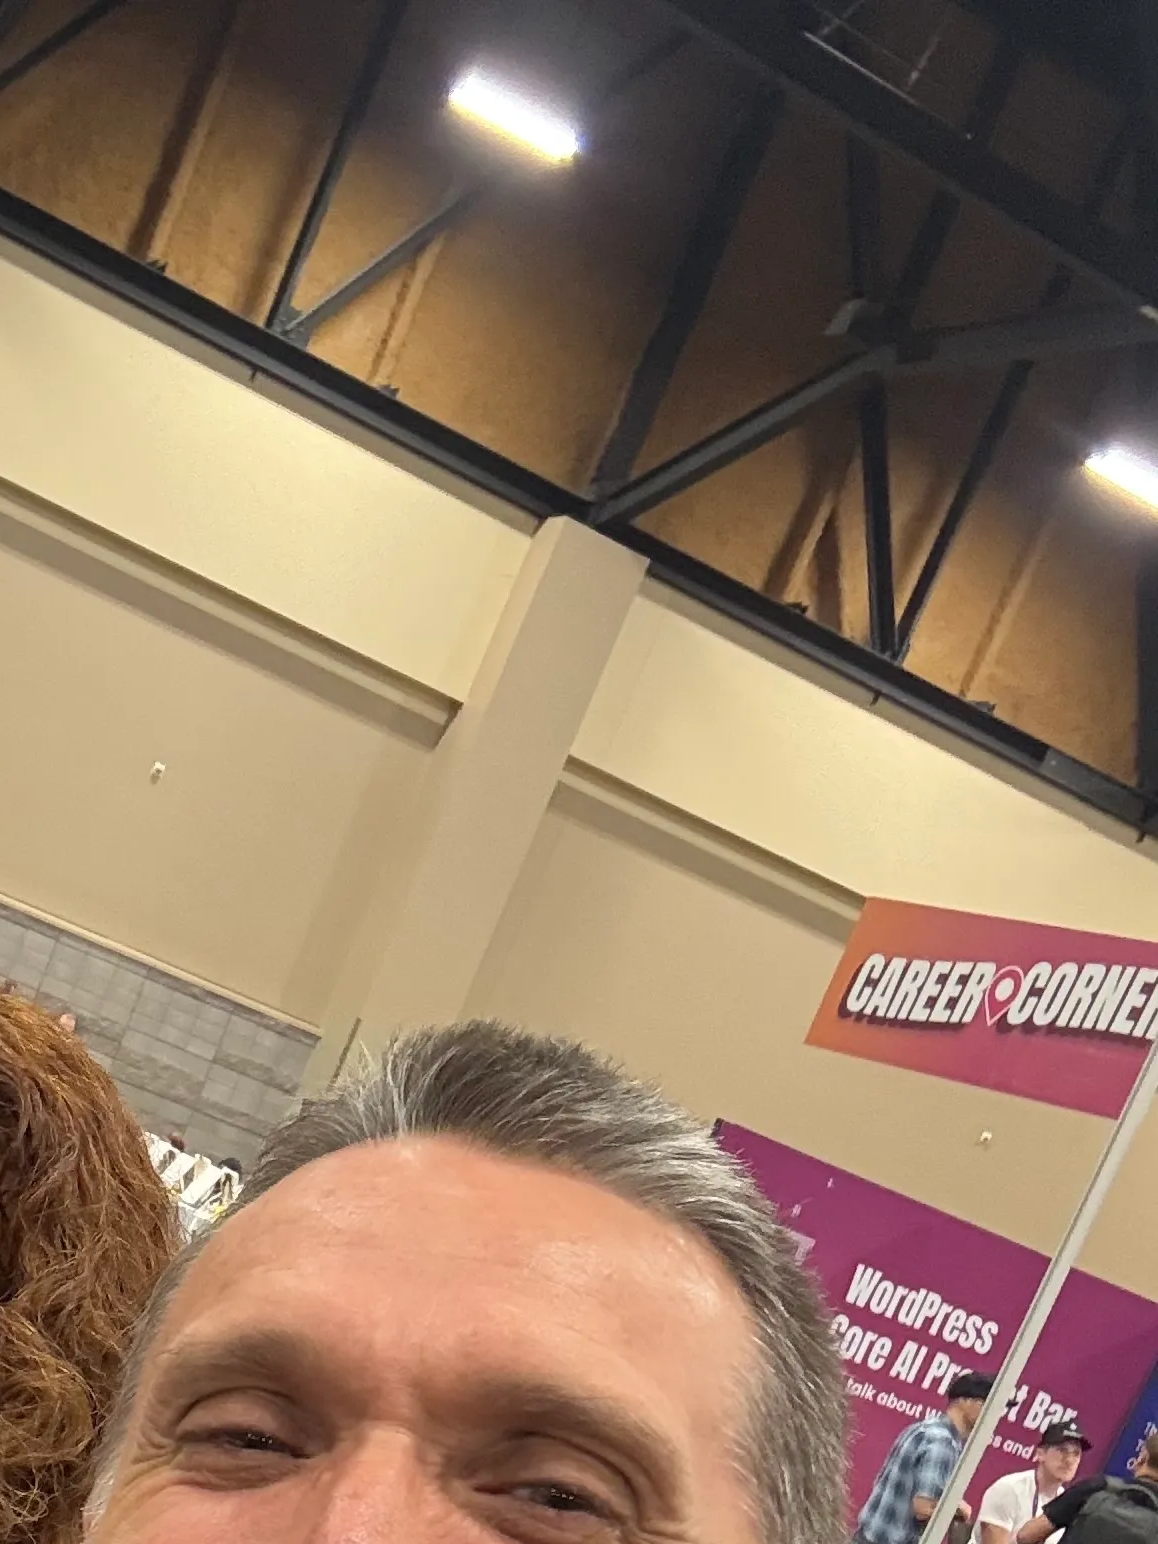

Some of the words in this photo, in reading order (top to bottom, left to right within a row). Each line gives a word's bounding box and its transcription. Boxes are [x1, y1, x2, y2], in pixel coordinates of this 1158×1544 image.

[845, 953, 996, 1024] CAREER
[845, 1263, 999, 1355] WordPress
[889, 1340, 929, 1384] AI
[876, 1391, 923, 1419] about
